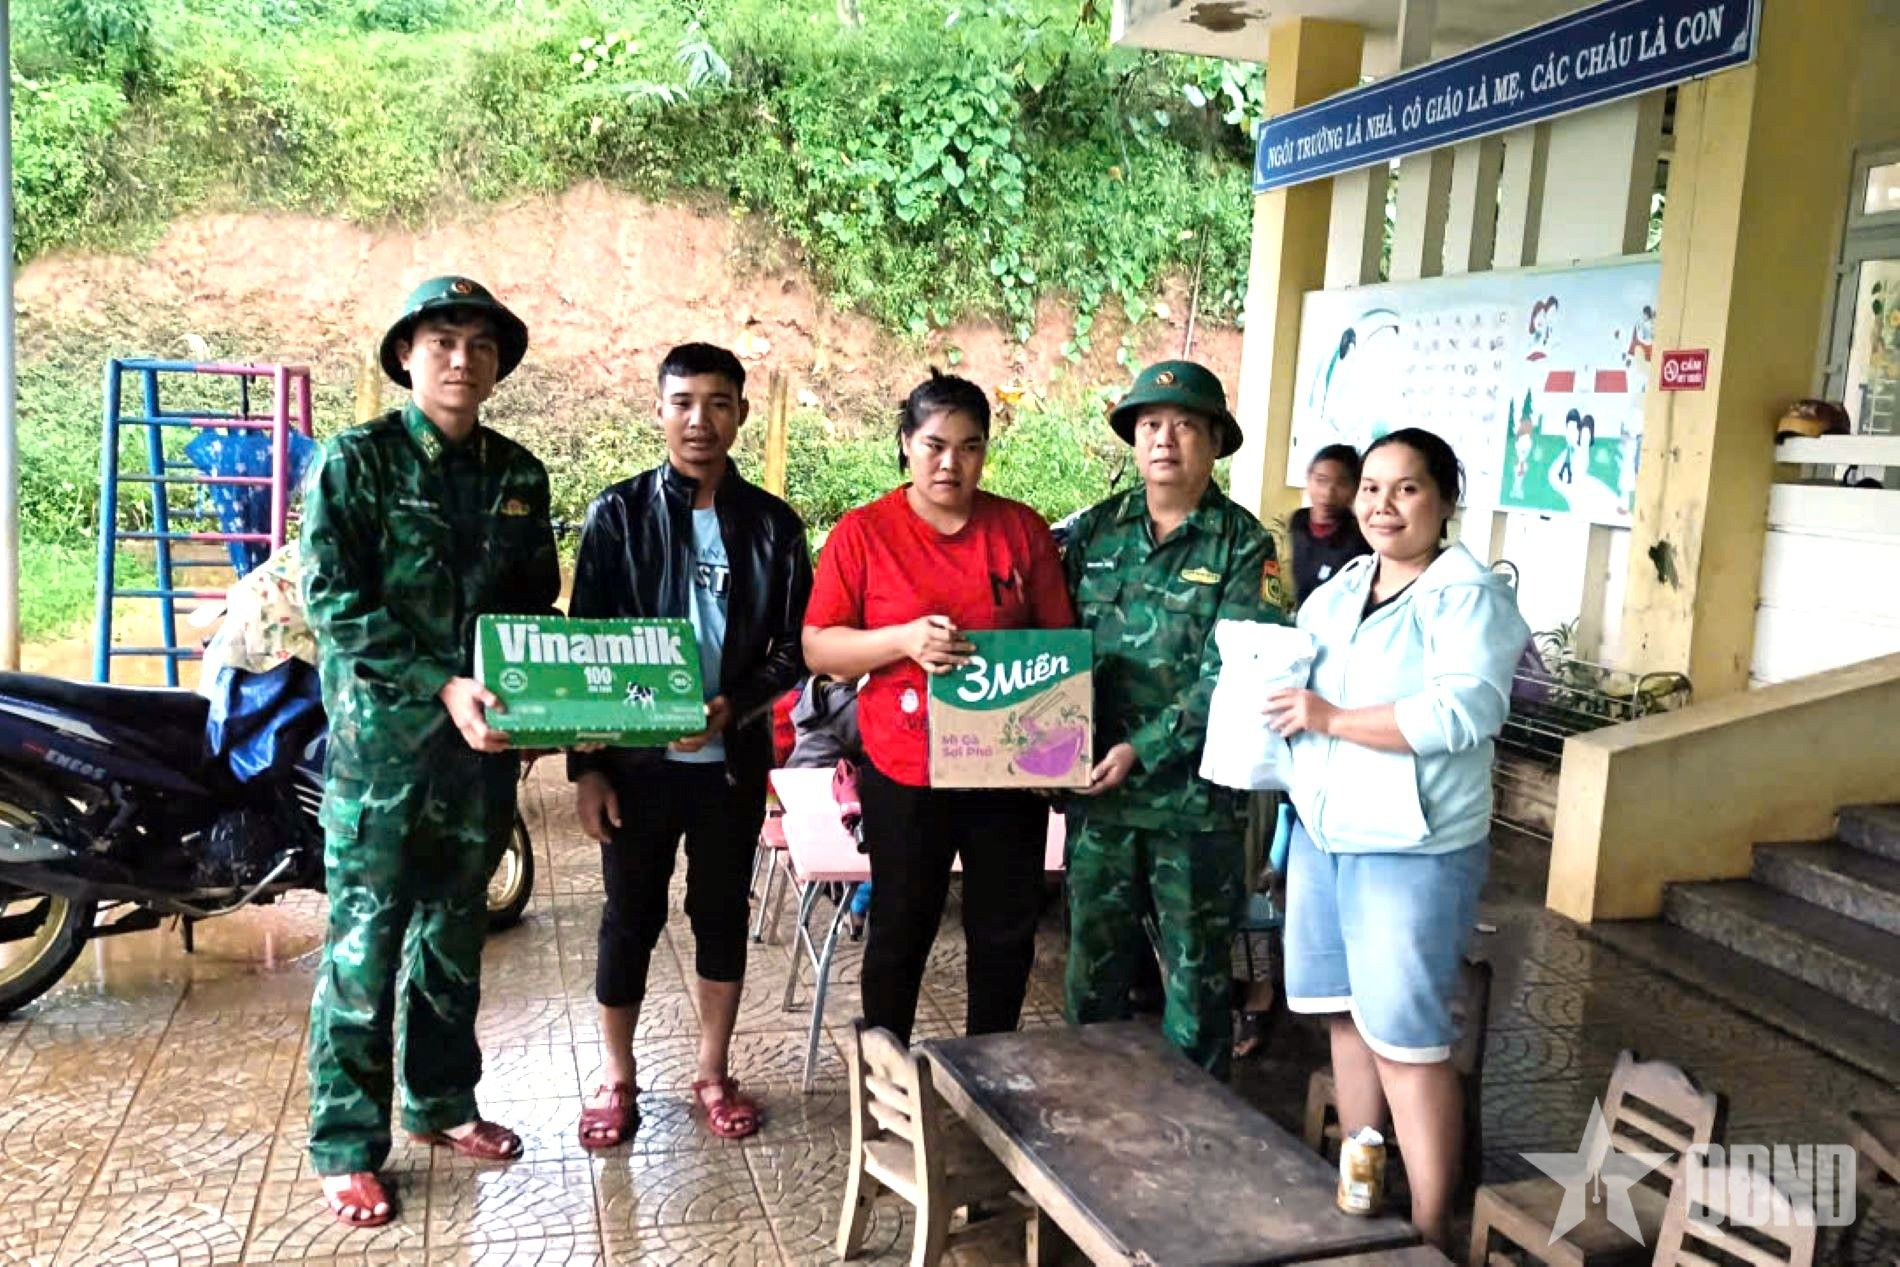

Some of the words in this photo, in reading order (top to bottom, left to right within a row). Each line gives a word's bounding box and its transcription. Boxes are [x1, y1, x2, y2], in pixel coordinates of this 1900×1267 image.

[1267, 136, 1293, 169] NGÔI
[1297, 125, 1343, 161] TRƯỜNG
[1345, 113, 1362, 147] LÀ
[1365, 105, 1397, 142] NHÀ,
[1402, 95, 1421, 132] CÔ
[1425, 86, 1463, 125] GIÁO
[1466, 74, 1488, 113] LÀ
[1492, 71, 1525, 107] MẸ,
[1530, 52, 1571, 94] CÁC
[1575, 31, 1634, 81] CHÁU
[1638, 16, 1667, 62] LÀ
[1675, 4, 1725, 50] CON
[496, 623, 687, 666] Vinamilk
[957, 655, 991, 702] 3
[987, 652, 1070, 701] Miền
